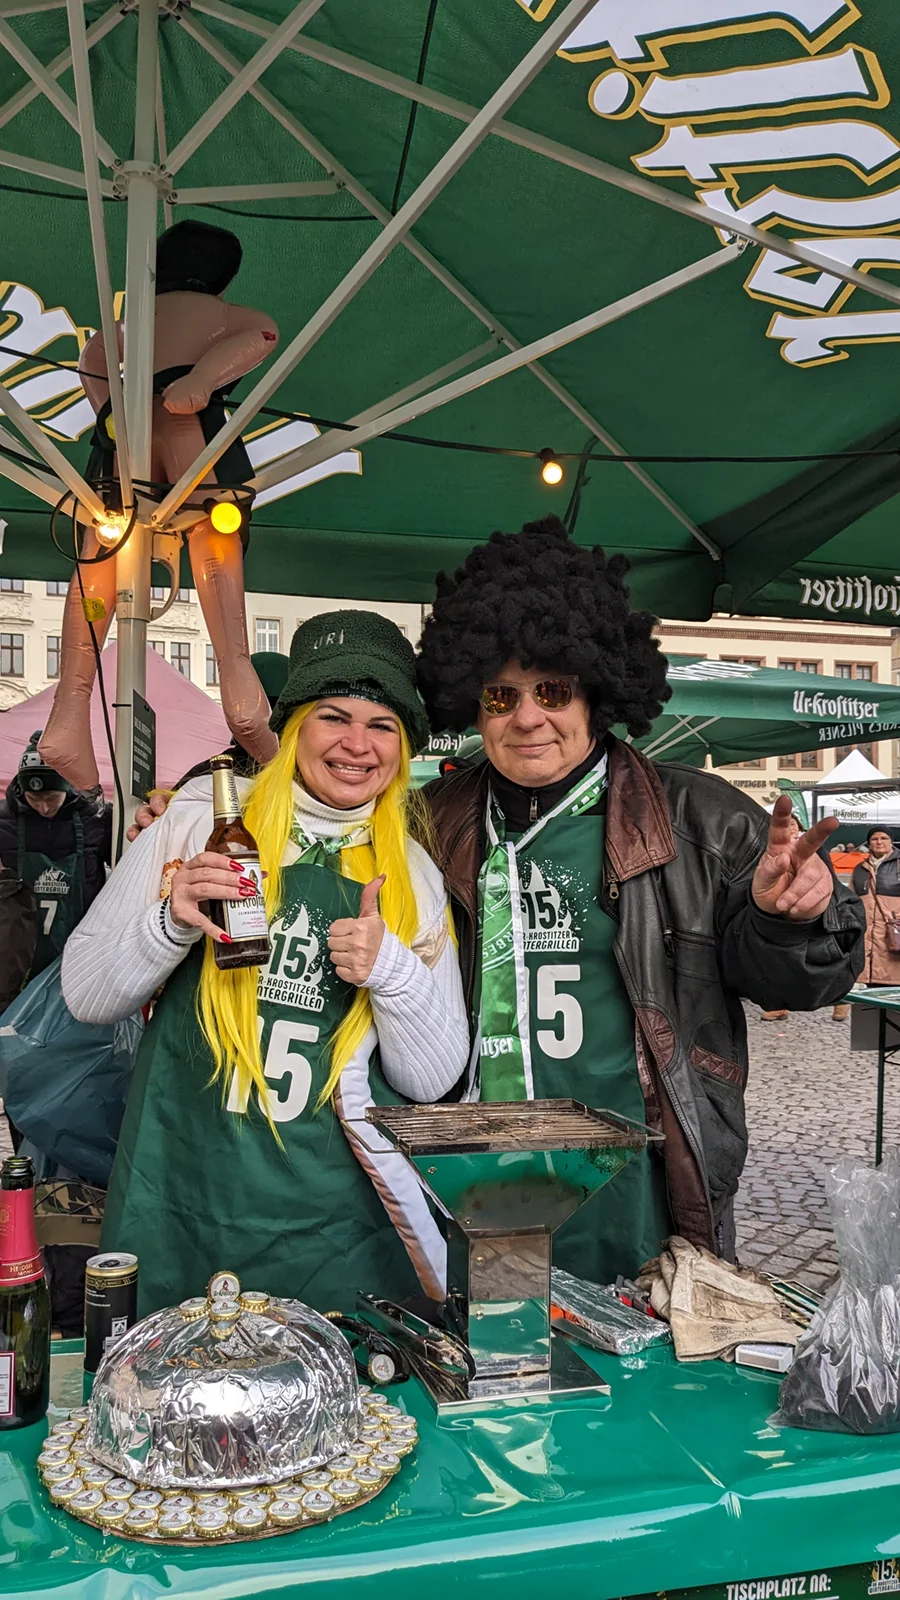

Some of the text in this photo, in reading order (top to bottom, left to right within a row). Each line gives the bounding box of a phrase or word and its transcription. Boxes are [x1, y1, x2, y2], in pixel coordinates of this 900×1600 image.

[313, 629, 345, 650] URI
[40, 900, 58, 935] 7
[522, 930, 571, 941] R-KROSTITZER
[269, 932, 312, 982] 15.
[258, 975, 317, 996] R-KROSTITZER
[257, 986, 322, 1010] NTERGRILLEN
[726, 1573, 832, 1600] TISCHPLATZ NR:
